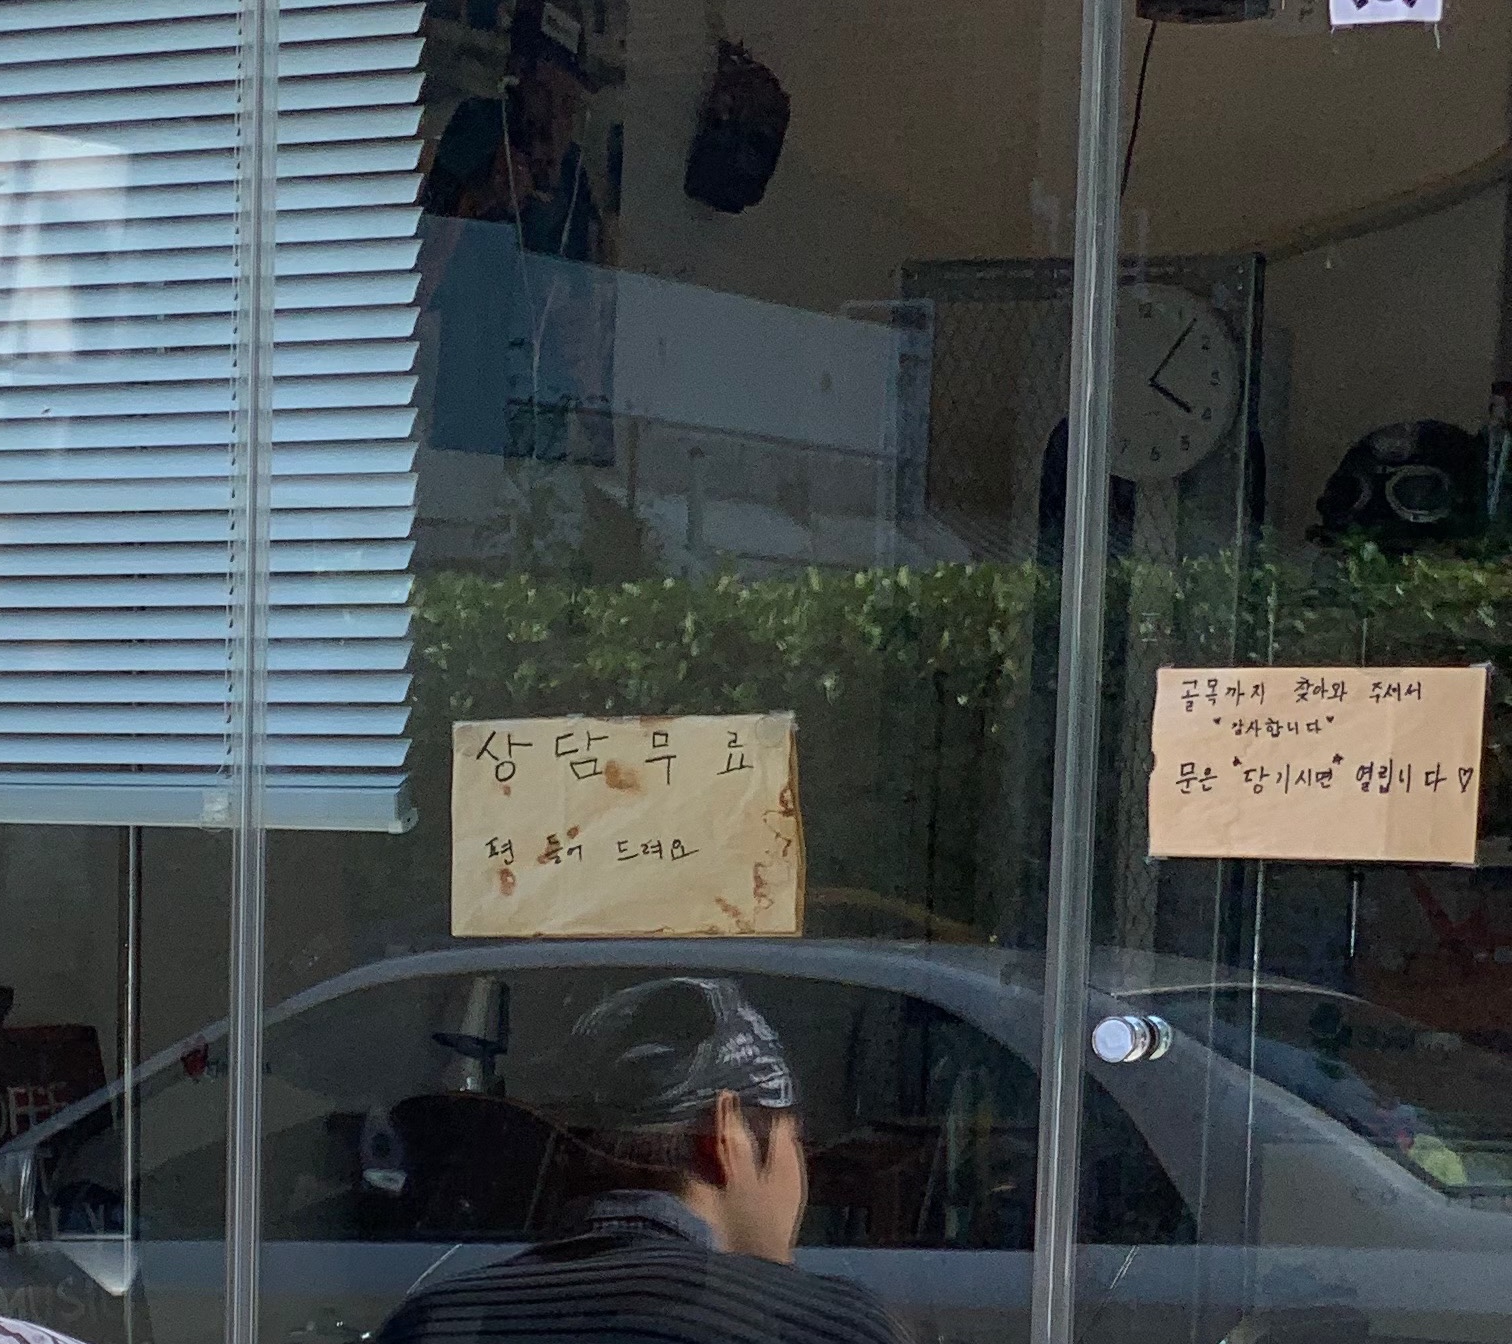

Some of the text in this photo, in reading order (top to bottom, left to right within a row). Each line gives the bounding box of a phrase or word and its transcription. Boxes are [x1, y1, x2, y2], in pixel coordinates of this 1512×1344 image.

[1180, 678, 1265, 712] 골목까지
[1293, 677, 1348, 703] 찾아와
[1231, 718, 1321, 738] 감사합니다
[1176, 762, 1218, 793] 문은
[1356, 759, 1447, 793] 열립니다
[617, 838, 700, 862] 드려요
